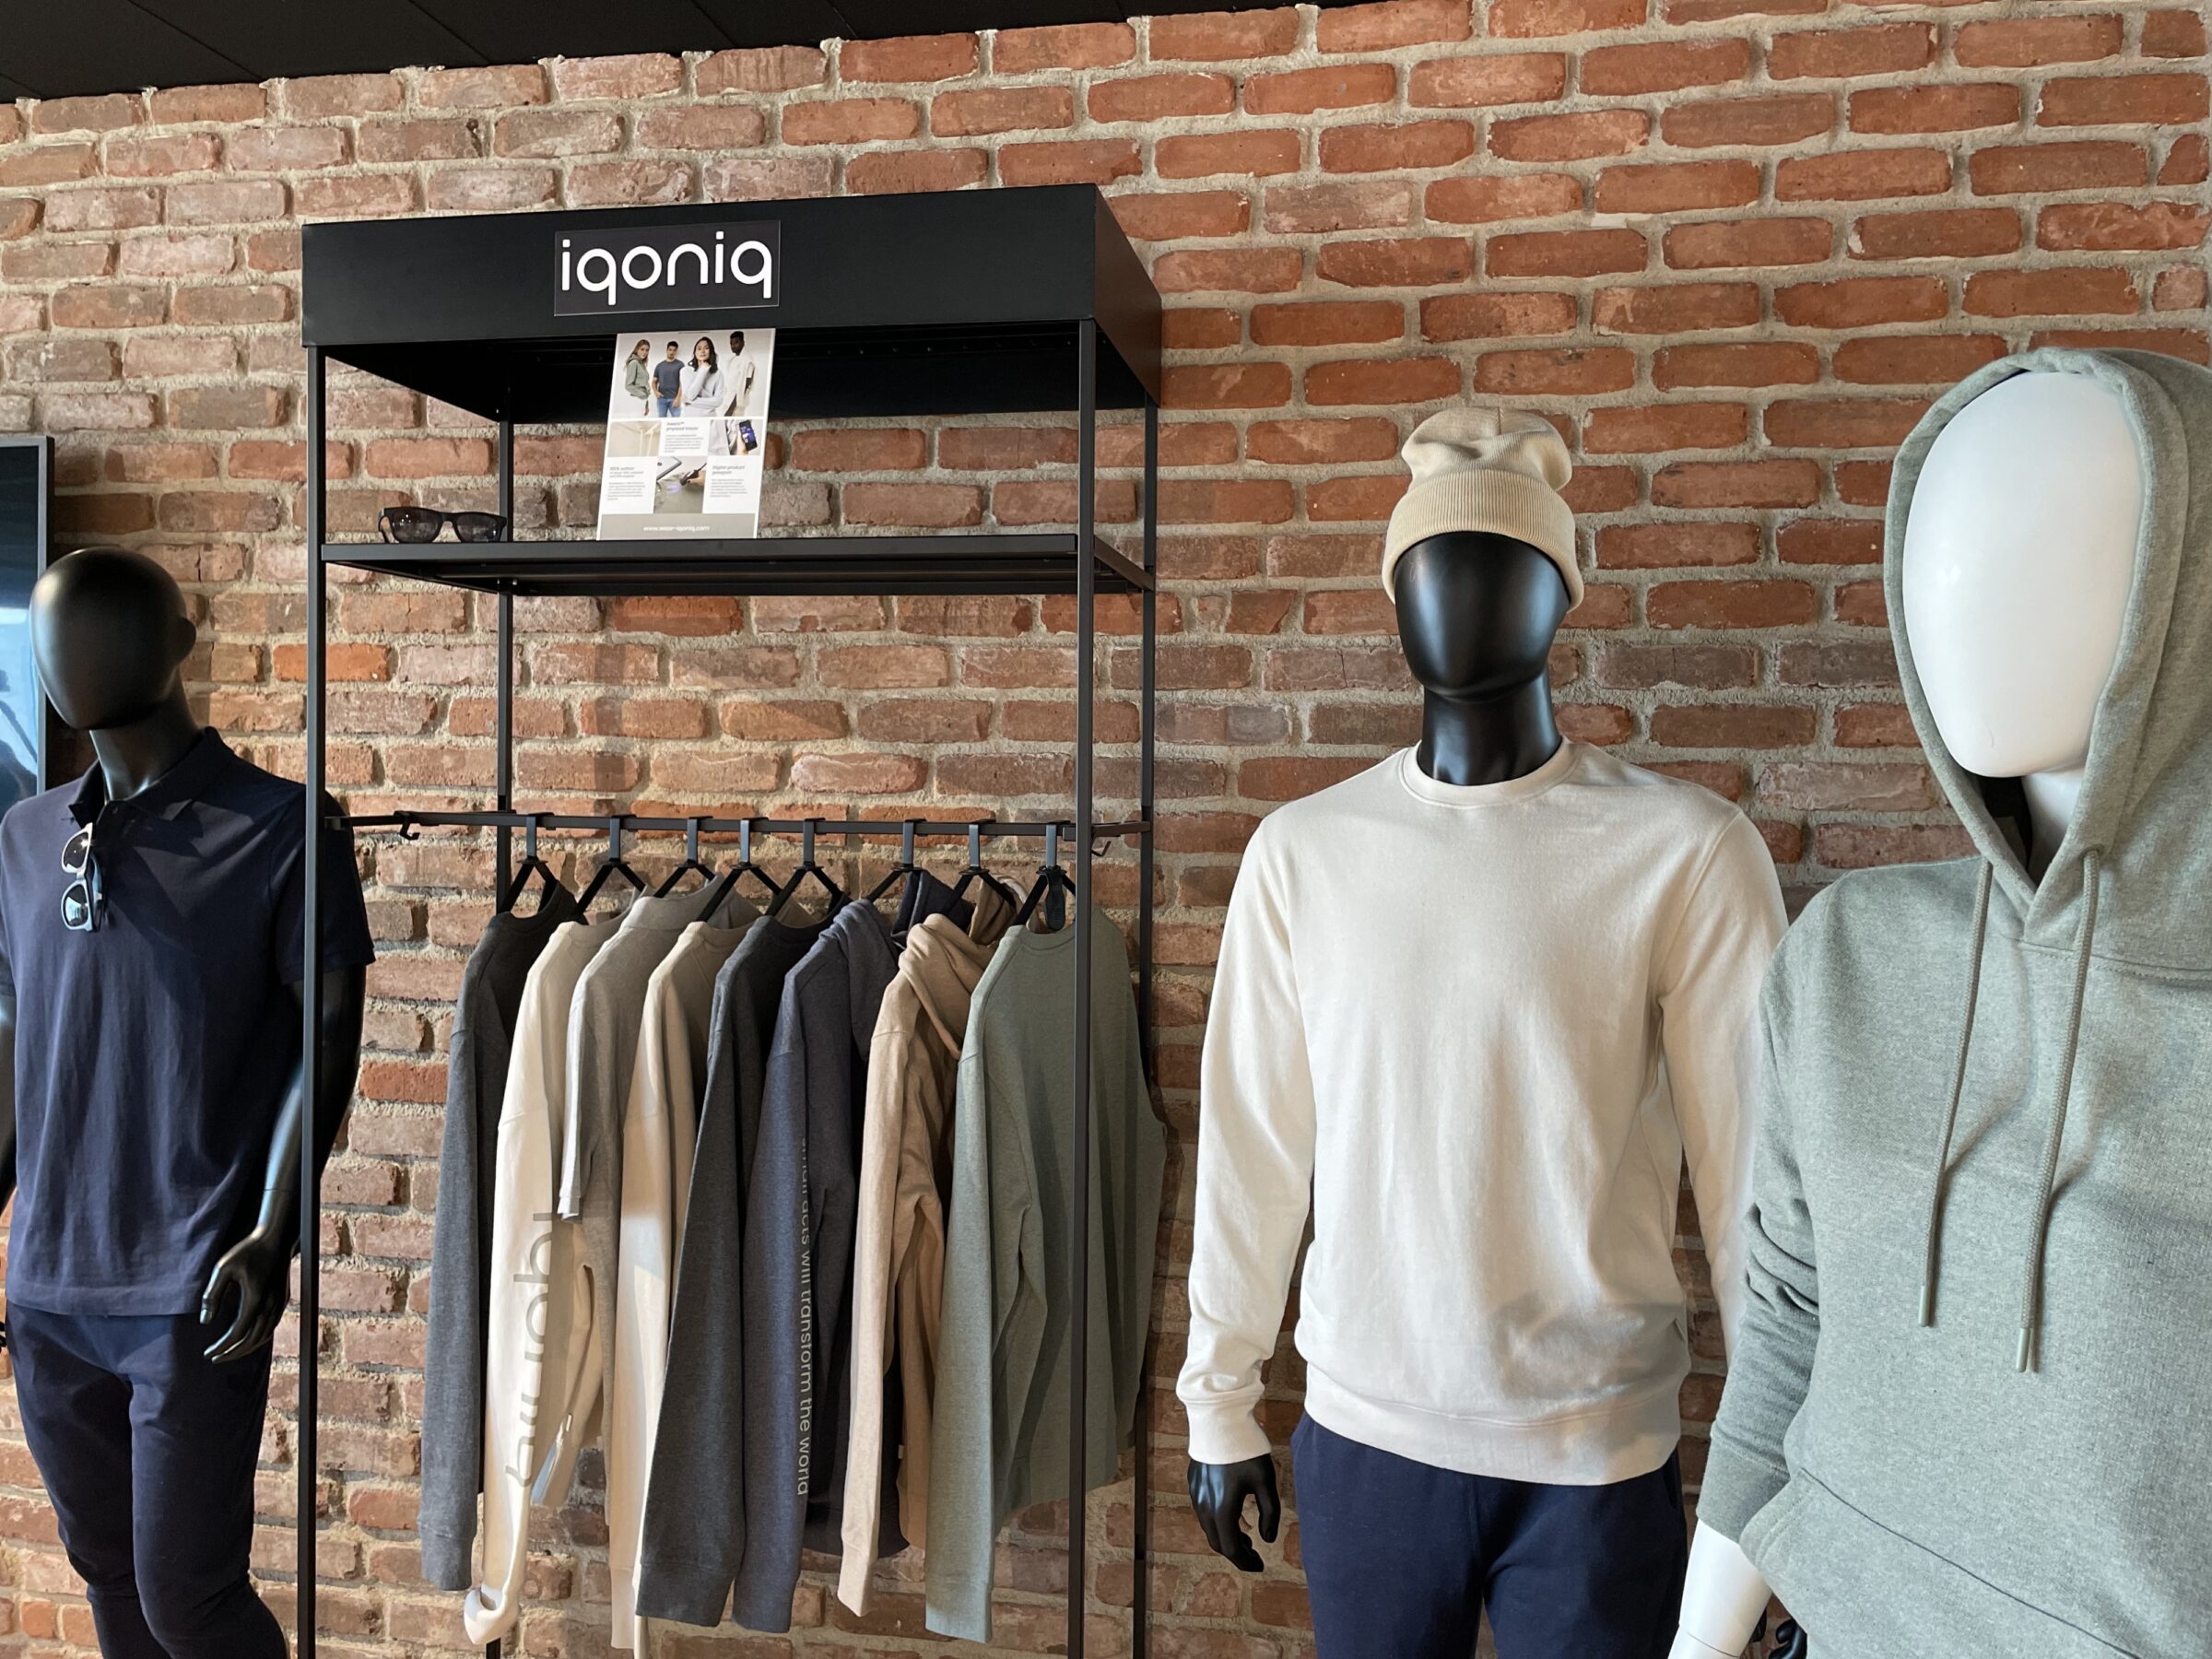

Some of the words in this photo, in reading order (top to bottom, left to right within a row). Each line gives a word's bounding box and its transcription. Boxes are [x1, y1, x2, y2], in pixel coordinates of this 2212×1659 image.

[562, 231, 771, 305] iqoniq
[800, 1288, 812, 1393] transform
[799, 1398, 812, 1432] the
